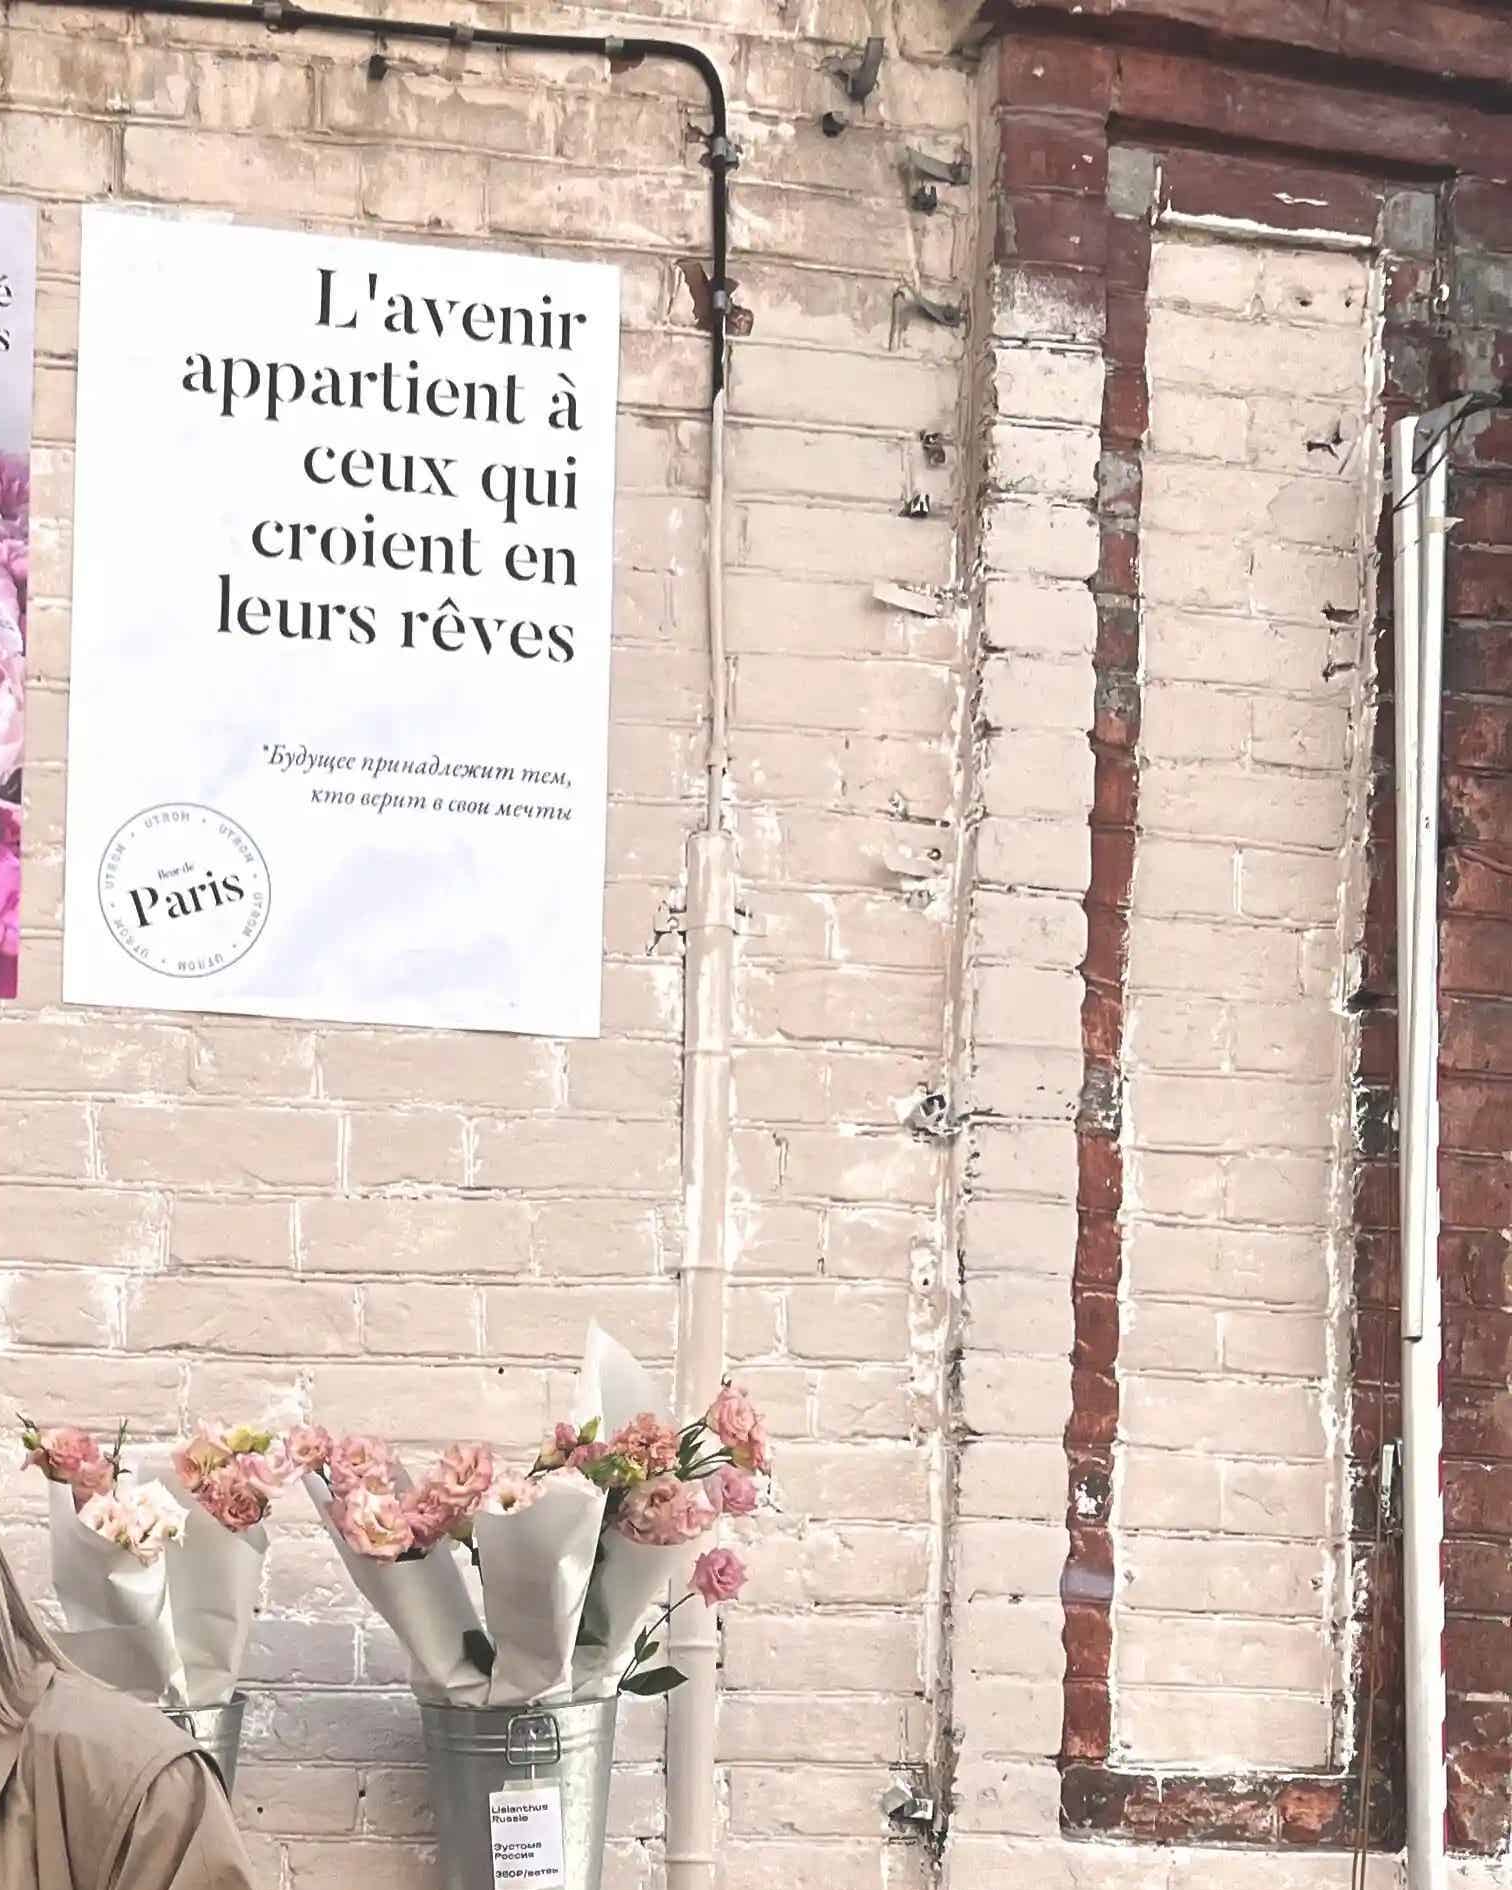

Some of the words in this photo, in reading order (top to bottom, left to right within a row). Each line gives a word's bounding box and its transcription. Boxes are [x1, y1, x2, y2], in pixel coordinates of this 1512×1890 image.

[314, 267, 588, 352] L'avenir
[181, 351, 527, 424] appartient
[548, 372, 583, 433] à
[303, 443, 459, 499] ceux
[481, 455, 579, 525] qui
[251, 513, 482, 578] croient
[505, 536, 578, 588] en
[218, 573, 377, 647] leurs
[400, 600, 576, 666] rêves
[311, 787, 355, 806] кто
[360, 793, 426, 815] верит
[432, 797, 443, 811] в
[448, 800, 489, 816] свои
[494, 803, 572, 822] мечты
[361, 755, 515, 780] принадлежит
[521, 768, 572, 788] тем,
[128, 870, 245, 928] Paris
